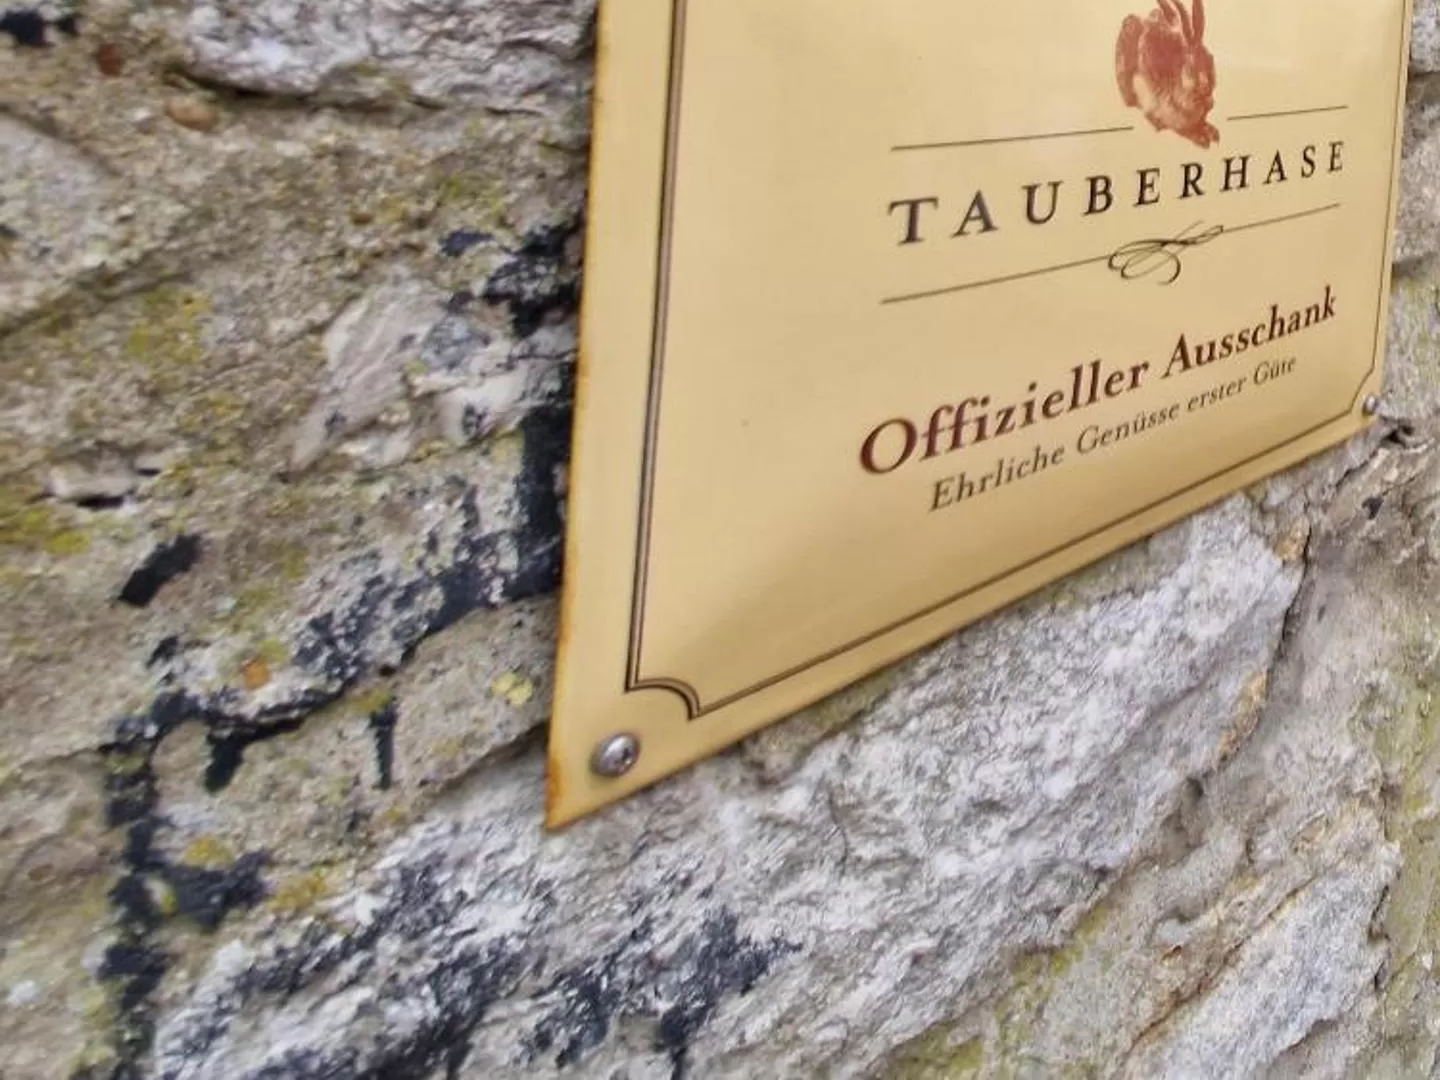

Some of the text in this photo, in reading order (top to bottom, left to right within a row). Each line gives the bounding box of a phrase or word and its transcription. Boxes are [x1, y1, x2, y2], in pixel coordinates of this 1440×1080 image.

[888, 140, 1345, 246] TAUBERHASE
[859, 284, 1337, 476] Offizieller Ausschank
[929, 354, 1297, 512] Ehrliche Genüsse erster Güte
